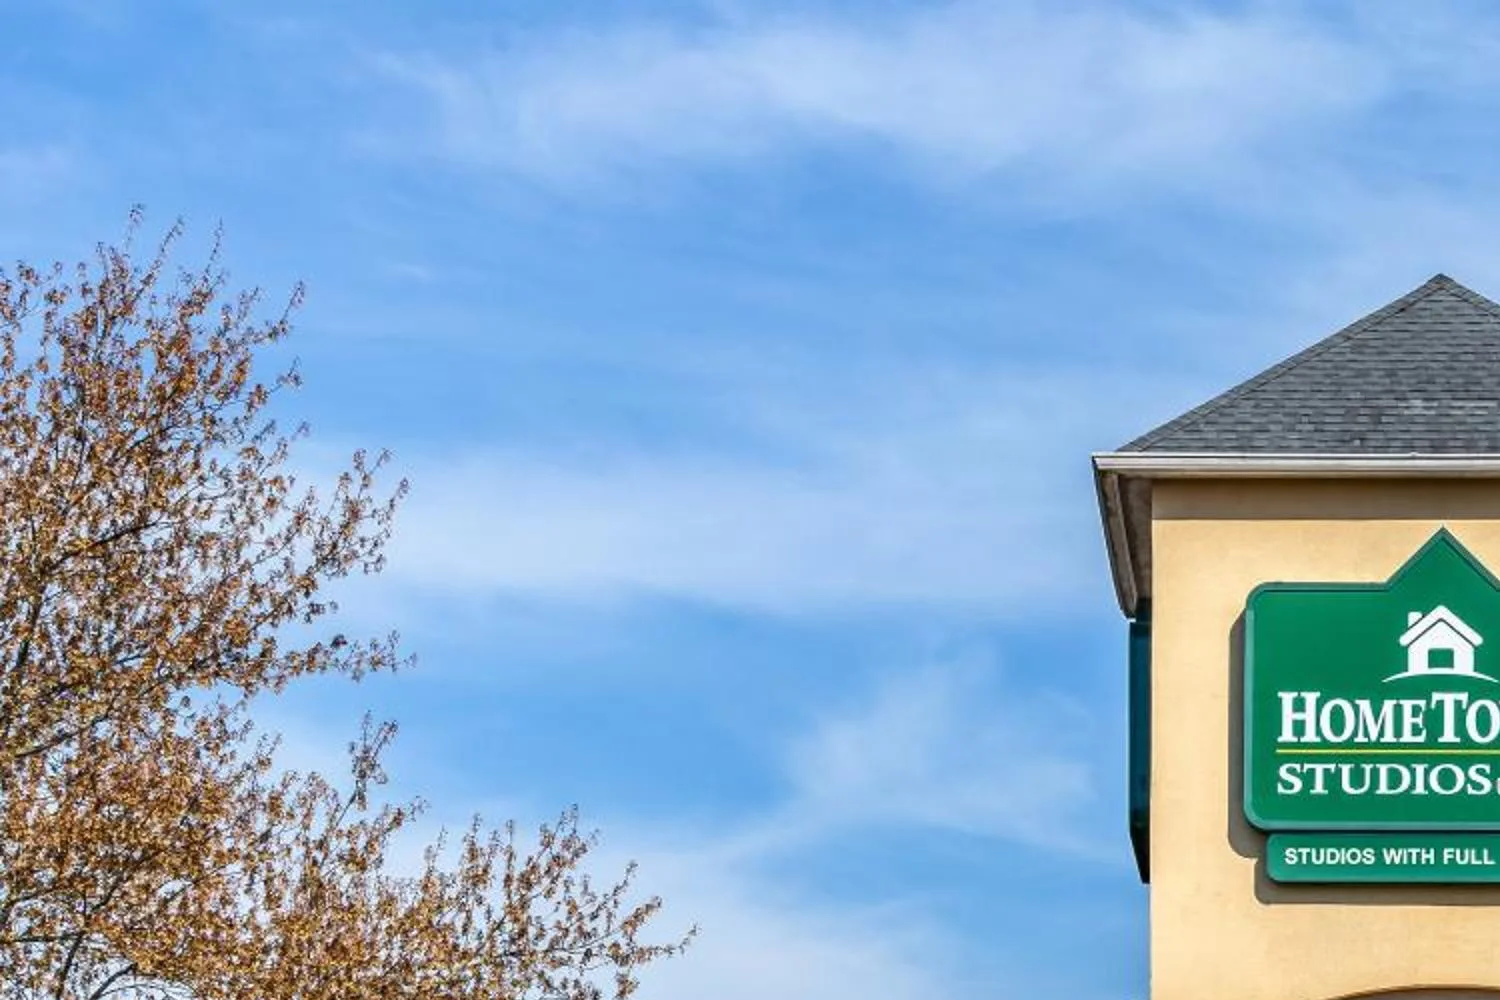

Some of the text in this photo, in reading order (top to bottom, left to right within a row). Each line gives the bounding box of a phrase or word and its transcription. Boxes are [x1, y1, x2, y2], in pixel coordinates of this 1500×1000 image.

[1277, 763, 1492, 795] STUDIOS
[1286, 848, 1375, 866] STUDIOS
[1383, 848, 1435, 866] WITH
[1443, 848, 1496, 866] FULL
